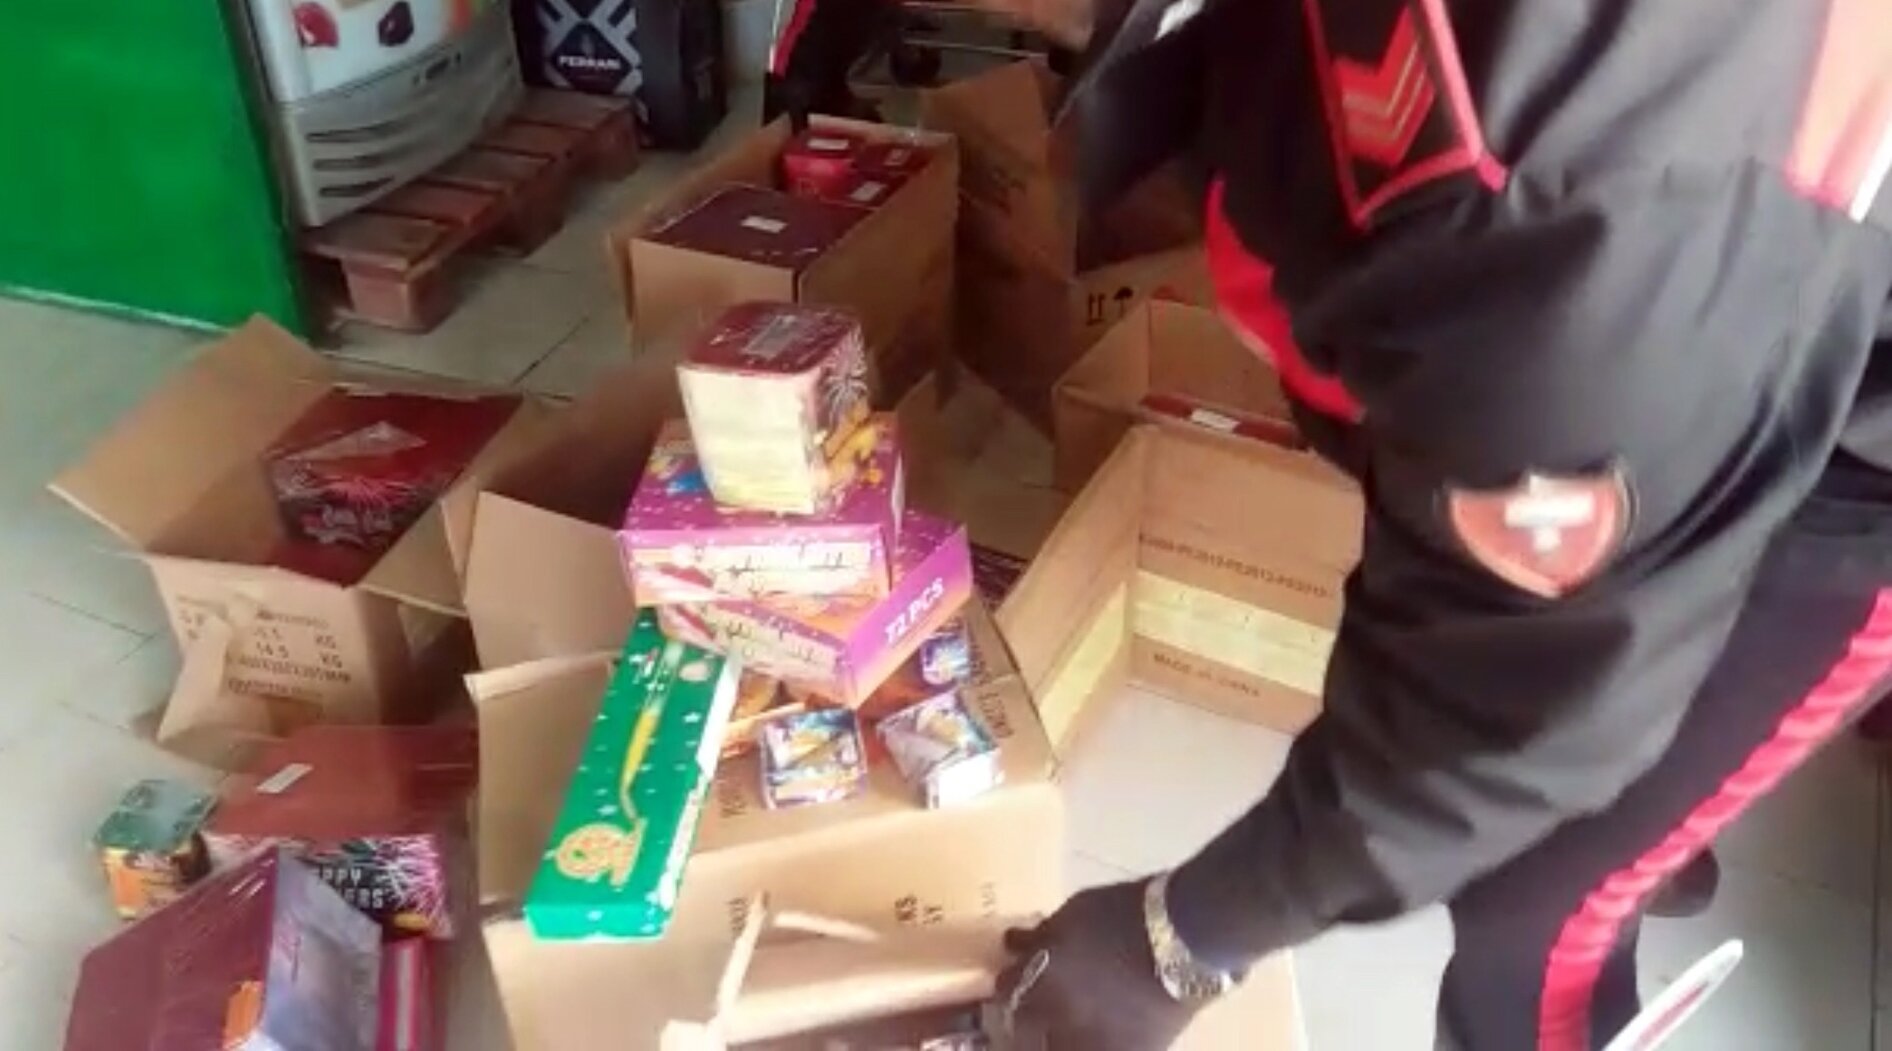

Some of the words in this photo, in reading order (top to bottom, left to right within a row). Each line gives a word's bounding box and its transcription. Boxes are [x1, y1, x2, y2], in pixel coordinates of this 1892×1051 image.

[884, 613, 906, 645] 72
[908, 577, 943, 623] PCS
[312, 866, 362, 888] PPY
[341, 887, 384, 910] ERS
